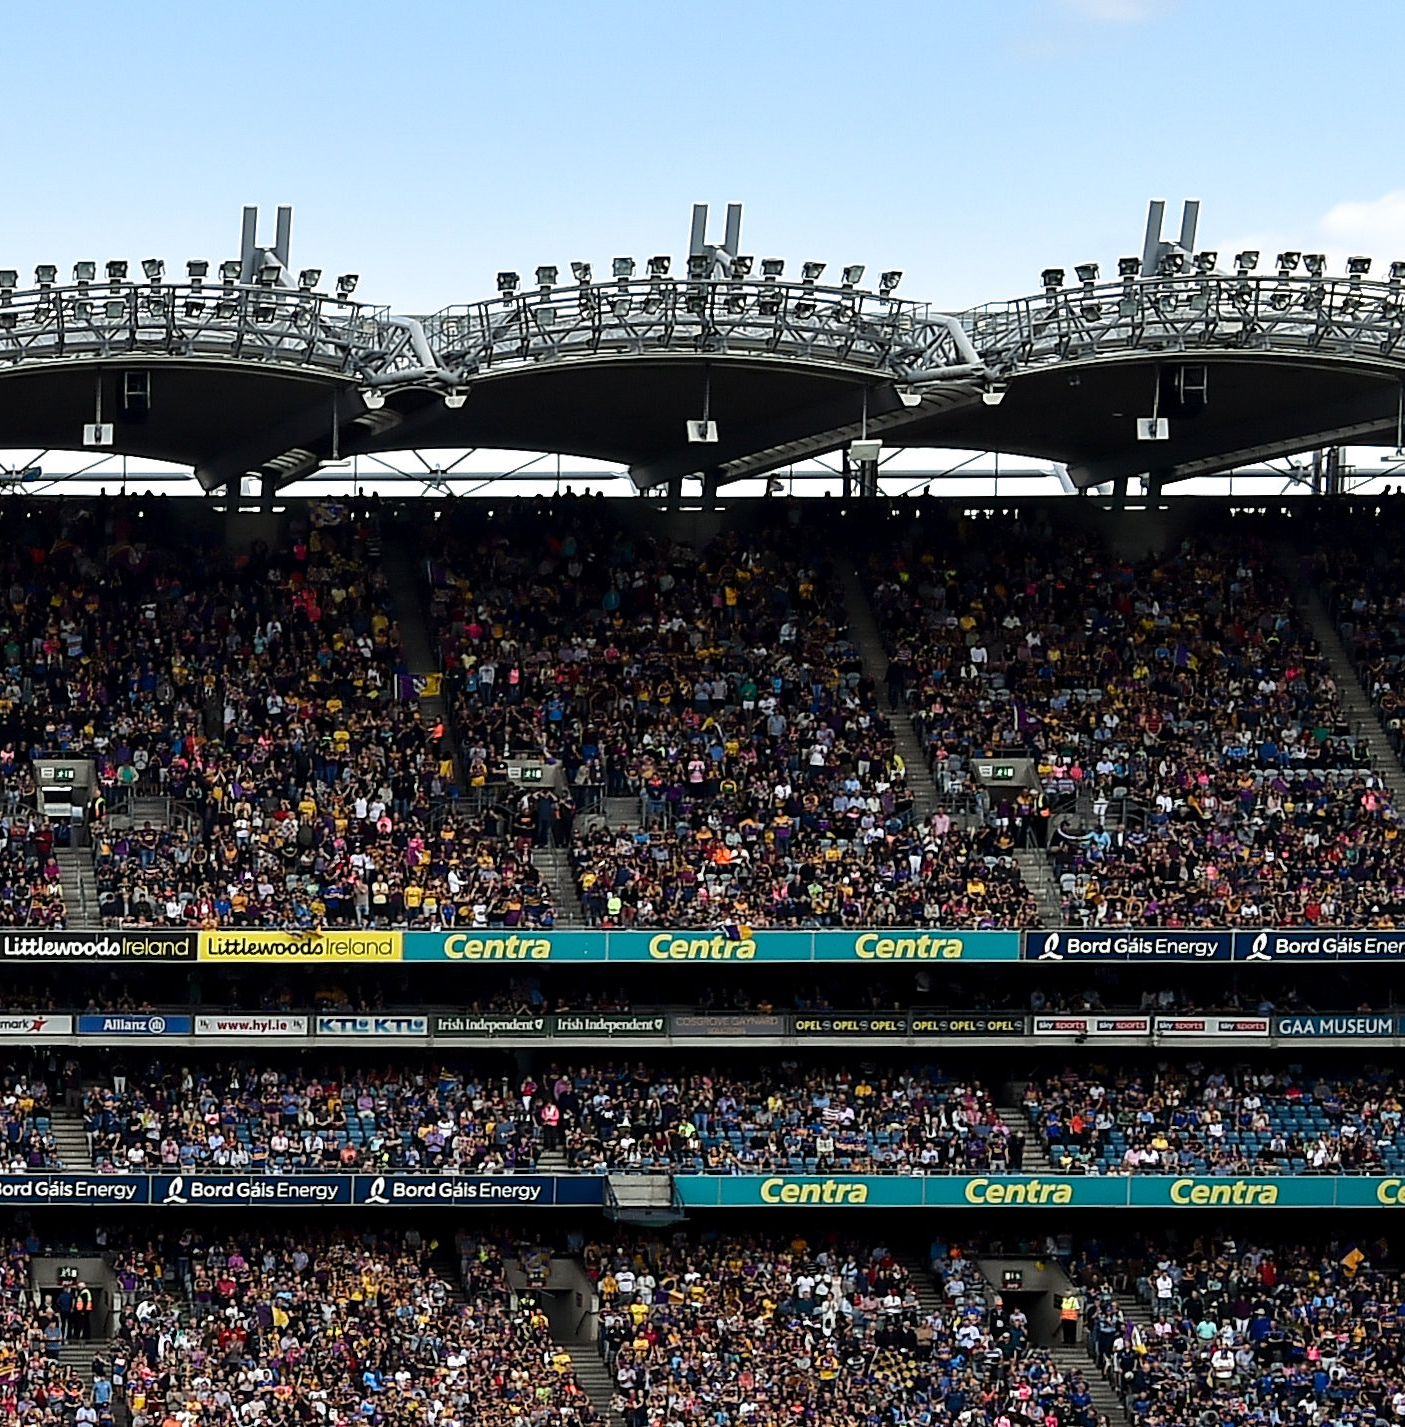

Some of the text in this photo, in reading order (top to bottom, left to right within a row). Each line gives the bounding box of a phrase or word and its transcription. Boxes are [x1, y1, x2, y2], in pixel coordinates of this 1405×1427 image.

[444, 935, 551, 958] Centra
[649, 935, 756, 958] Centra
[856, 934, 962, 958] Centra
[1068, 936, 1218, 956] Bord Gáis Energy
[1276, 938, 1320, 953] Bord
[1323, 936, 1362, 954] Gáis
[103, 1018, 147, 1030] Allianz
[218, 1020, 286, 1032] www.hyl.ie
[439, 1019, 533, 1033] Irish Independent
[796, 1021, 822, 1030] OPEL
[871, 1021, 896, 1030] OPEL
[950, 1021, 975, 1030] OPEL
[1098, 1021, 1146, 1031] sky sports
[1158, 1021, 1204, 1031] sky sports
[1280, 1019, 1392, 1034] GAA MUSEUM
[393, 1180, 540, 1200] Bord Gáis Energy
[761, 1179, 868, 1202] Centra
[965, 1180, 1072, 1203] Centra
[1171, 1179, 1277, 1204] Centra
